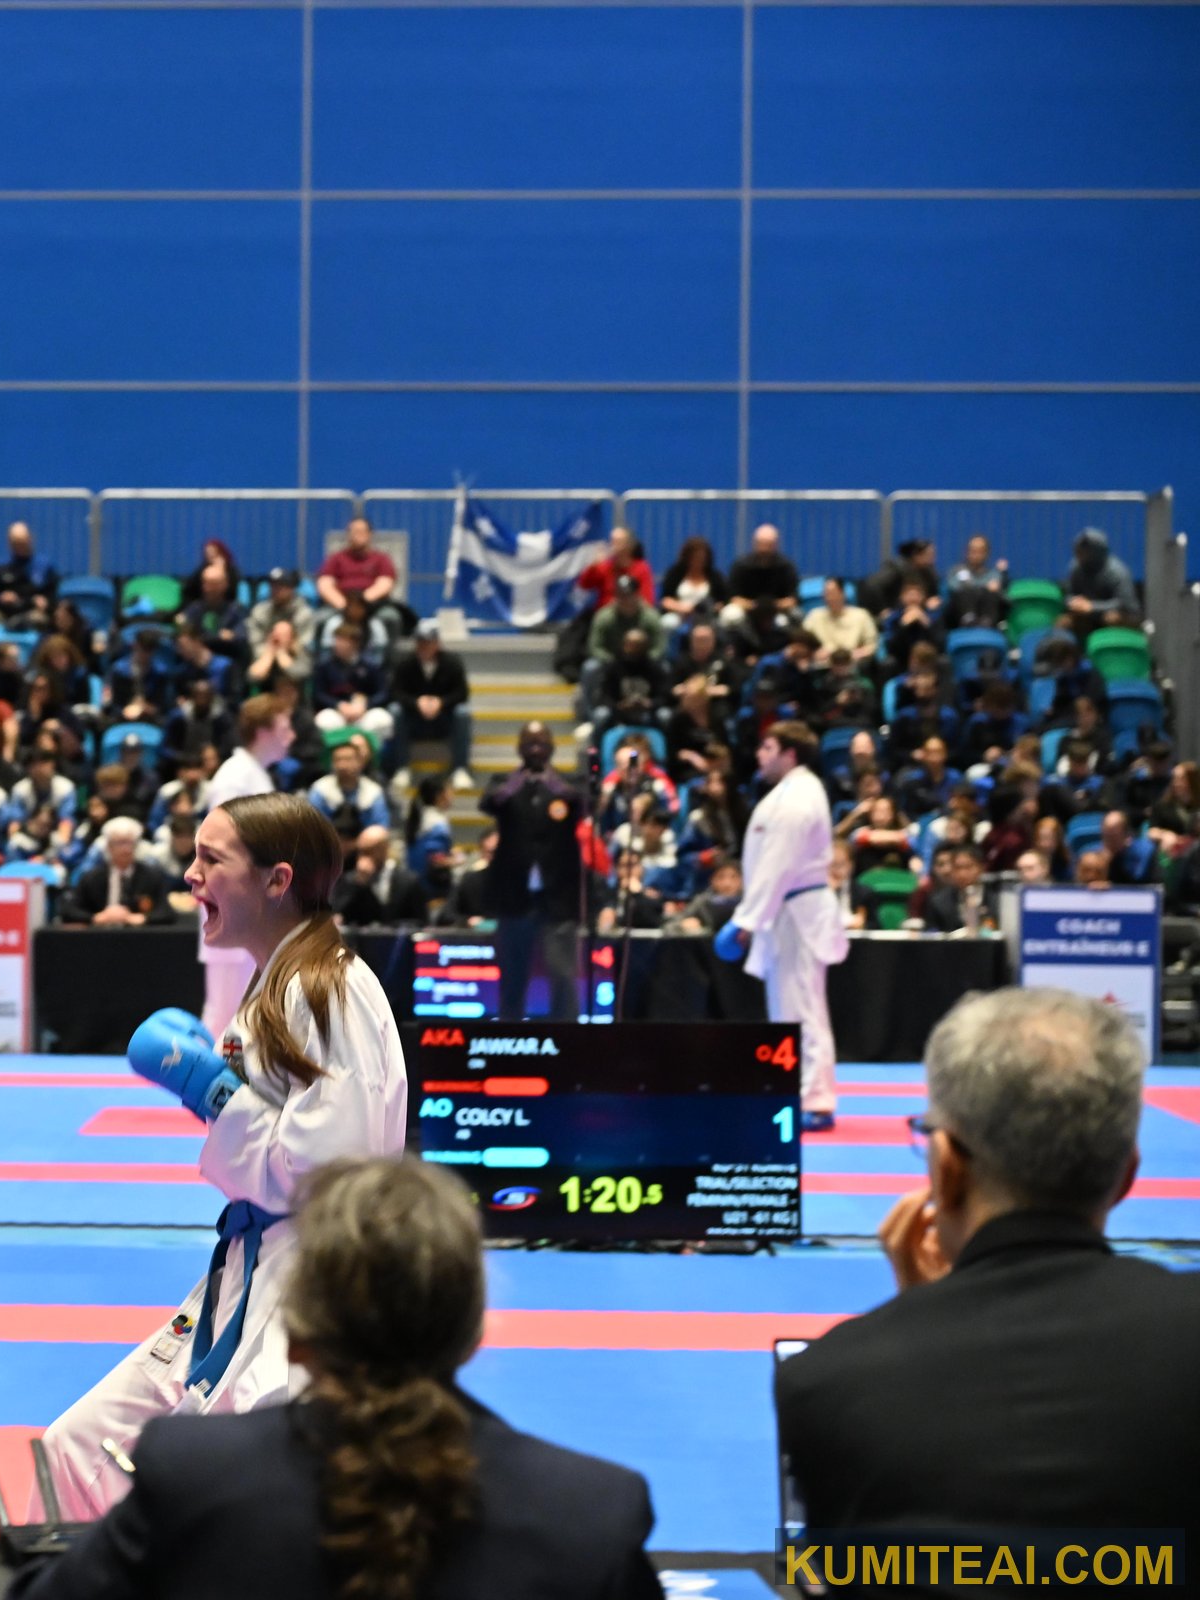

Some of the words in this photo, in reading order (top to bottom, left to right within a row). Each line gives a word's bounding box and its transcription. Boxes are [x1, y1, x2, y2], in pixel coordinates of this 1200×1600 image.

[421, 1028, 465, 1046] AKA
[771, 1036, 798, 1071] 4
[419, 1098, 453, 1118] AO
[772, 1105, 794, 1143] 1
